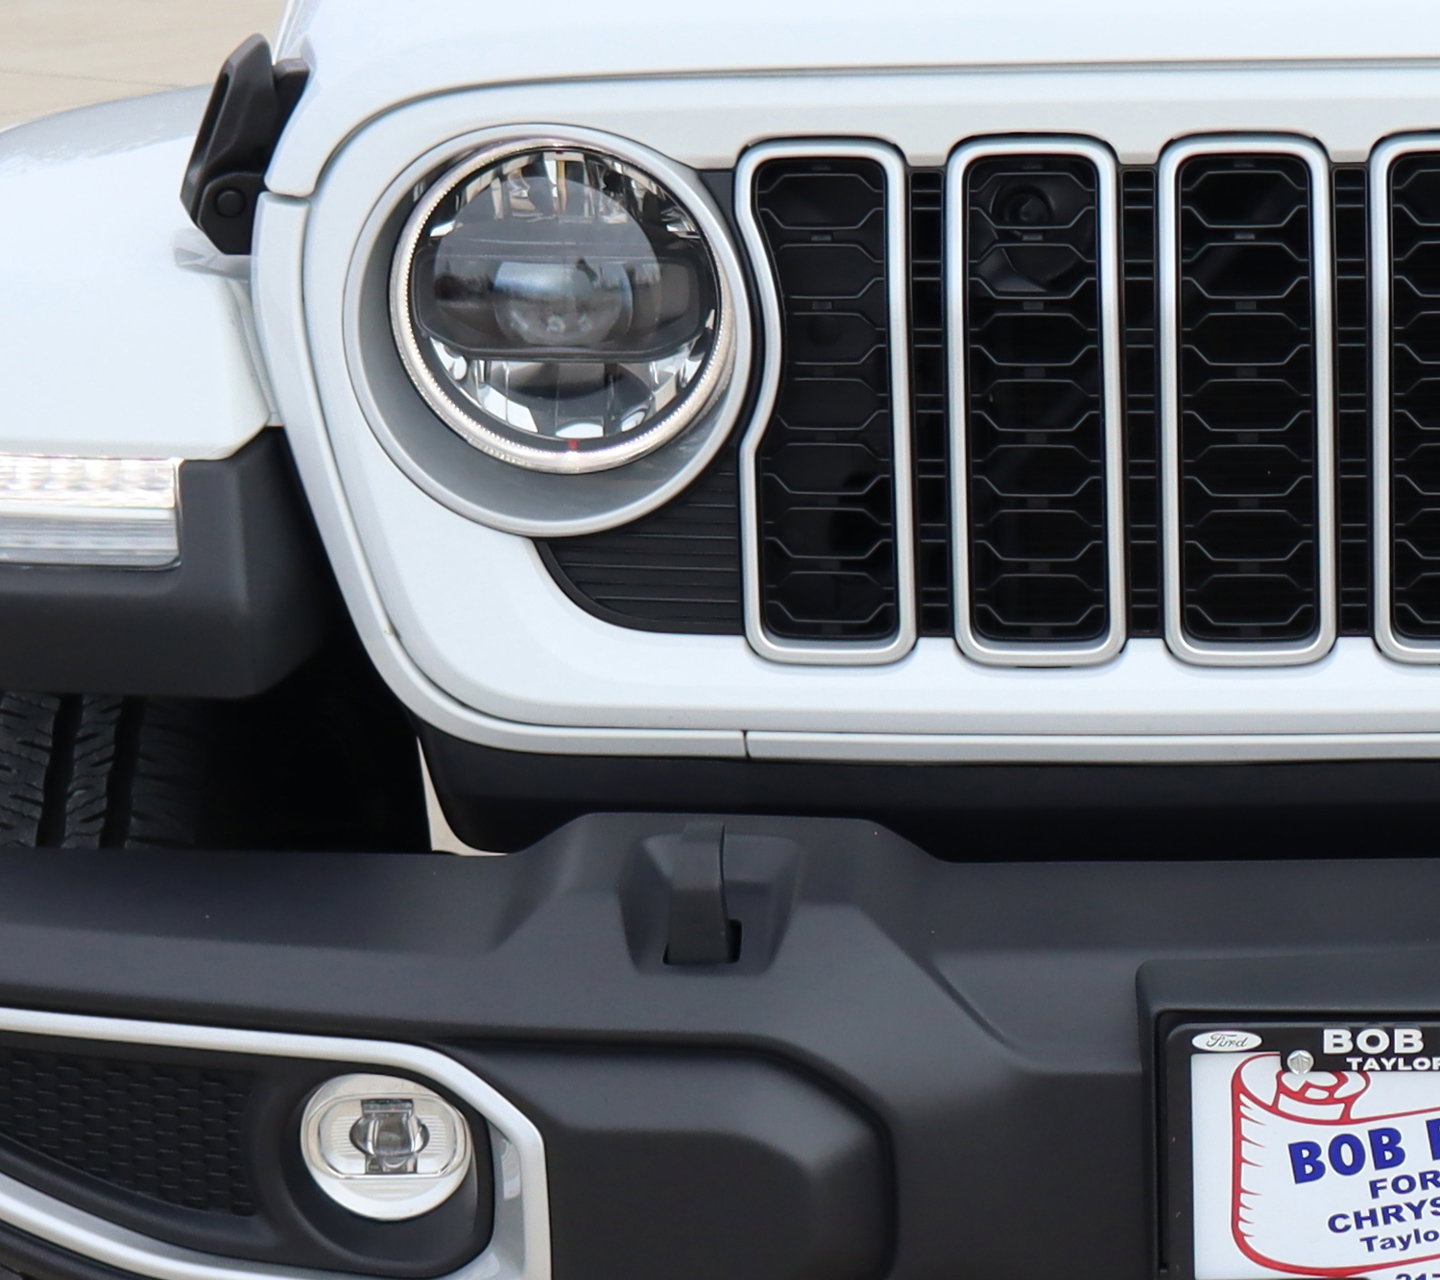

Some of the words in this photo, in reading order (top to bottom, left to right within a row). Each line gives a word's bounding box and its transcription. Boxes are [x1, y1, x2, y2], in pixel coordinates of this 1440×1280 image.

[1206, 1033, 1249, 1048] Ford
[1323, 1028, 1424, 1055] BOB
[1288, 1127, 1406, 1184] BOB
